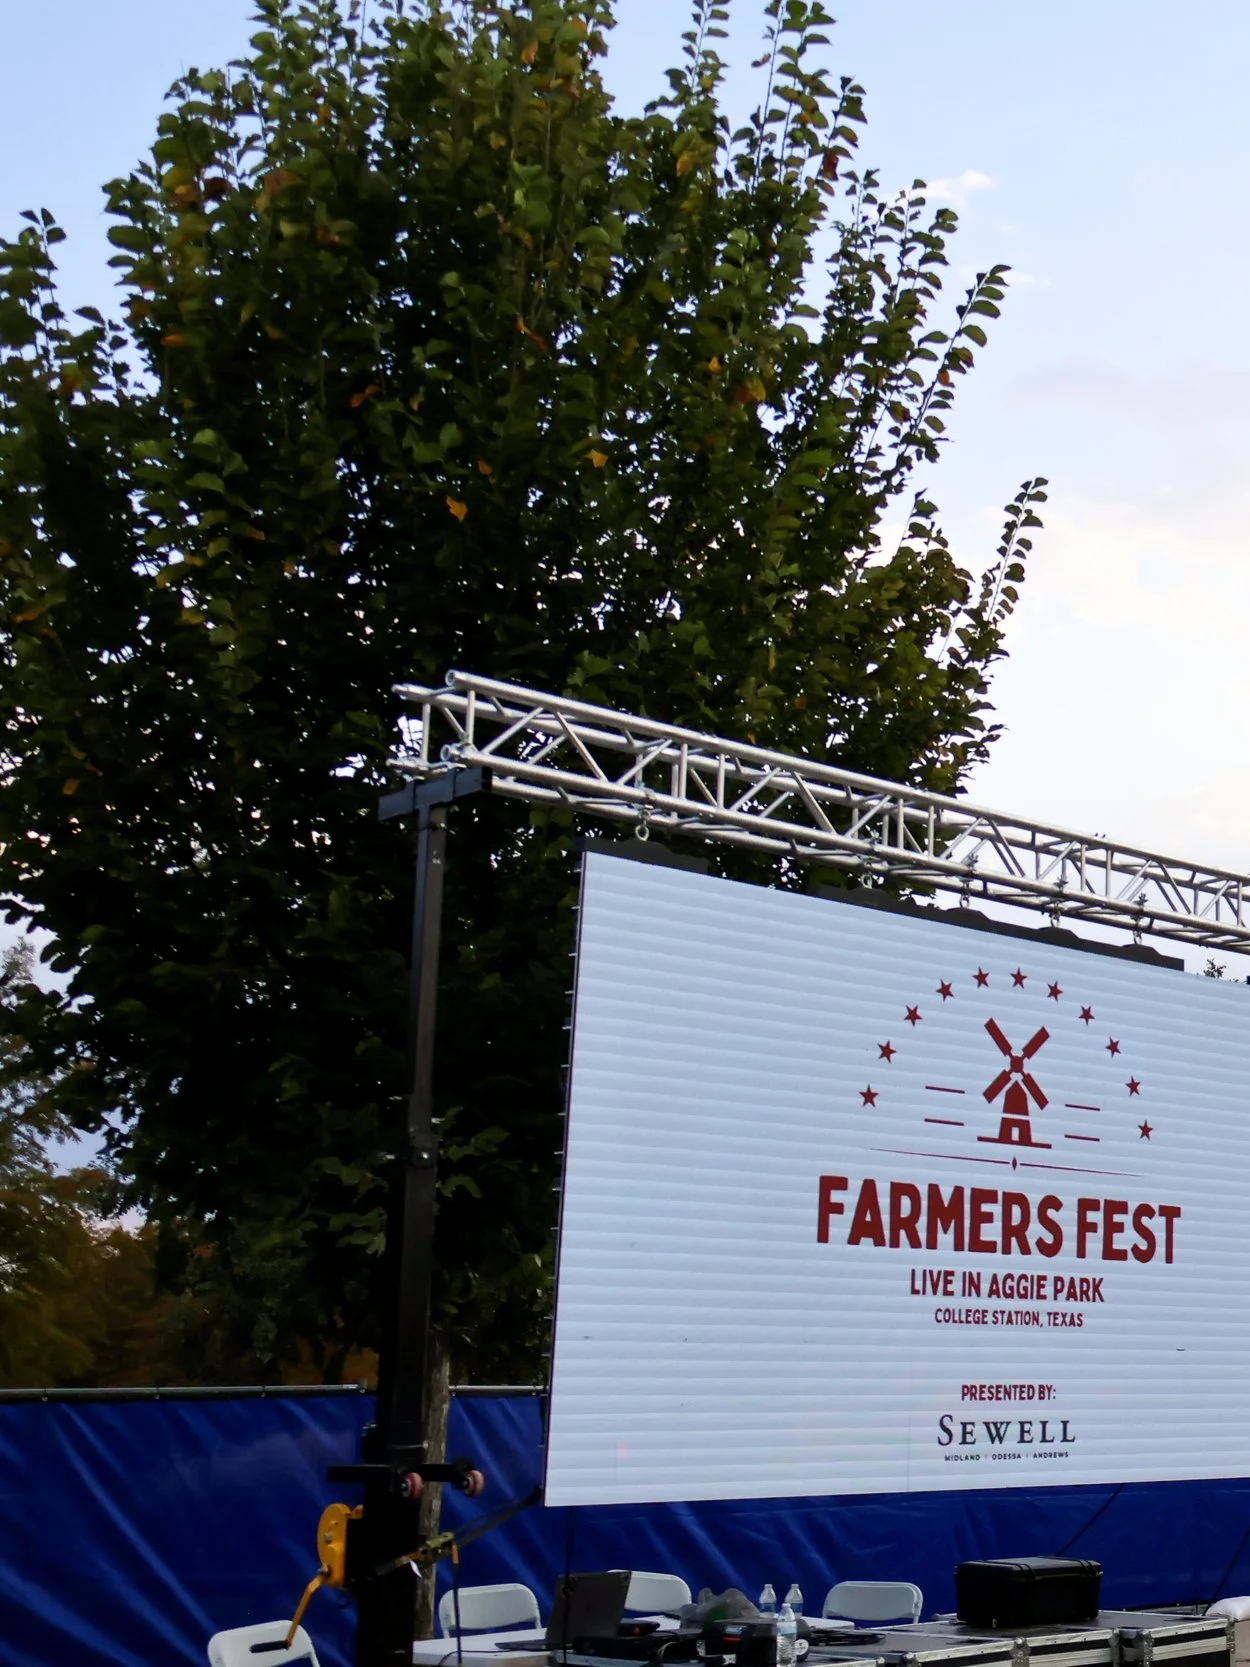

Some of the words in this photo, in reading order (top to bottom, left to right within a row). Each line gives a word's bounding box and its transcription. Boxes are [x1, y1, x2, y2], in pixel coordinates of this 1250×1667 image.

[817, 1175, 1064, 1258] FARMERS
[1076, 1197, 1181, 1264] FEST
[910, 1269, 954, 1296] LIVE
[962, 1272, 981, 1297] IN
[987, 1272, 1047, 1300] AGGIE
[1053, 1276, 1104, 1302] PARK
[934, 1308, 988, 1325] COLLEGE
[992, 1311, 1043, 1328] STATION,
[1047, 1312, 1083, 1327] TEXAS
[961, 1384, 1035, 1401] PRESENTED
[1038, 1384, 1056, 1400] BY:
[937, 1414, 1076, 1446] SEWELL
[1033, 1451, 1069, 1459] ANDREWS
